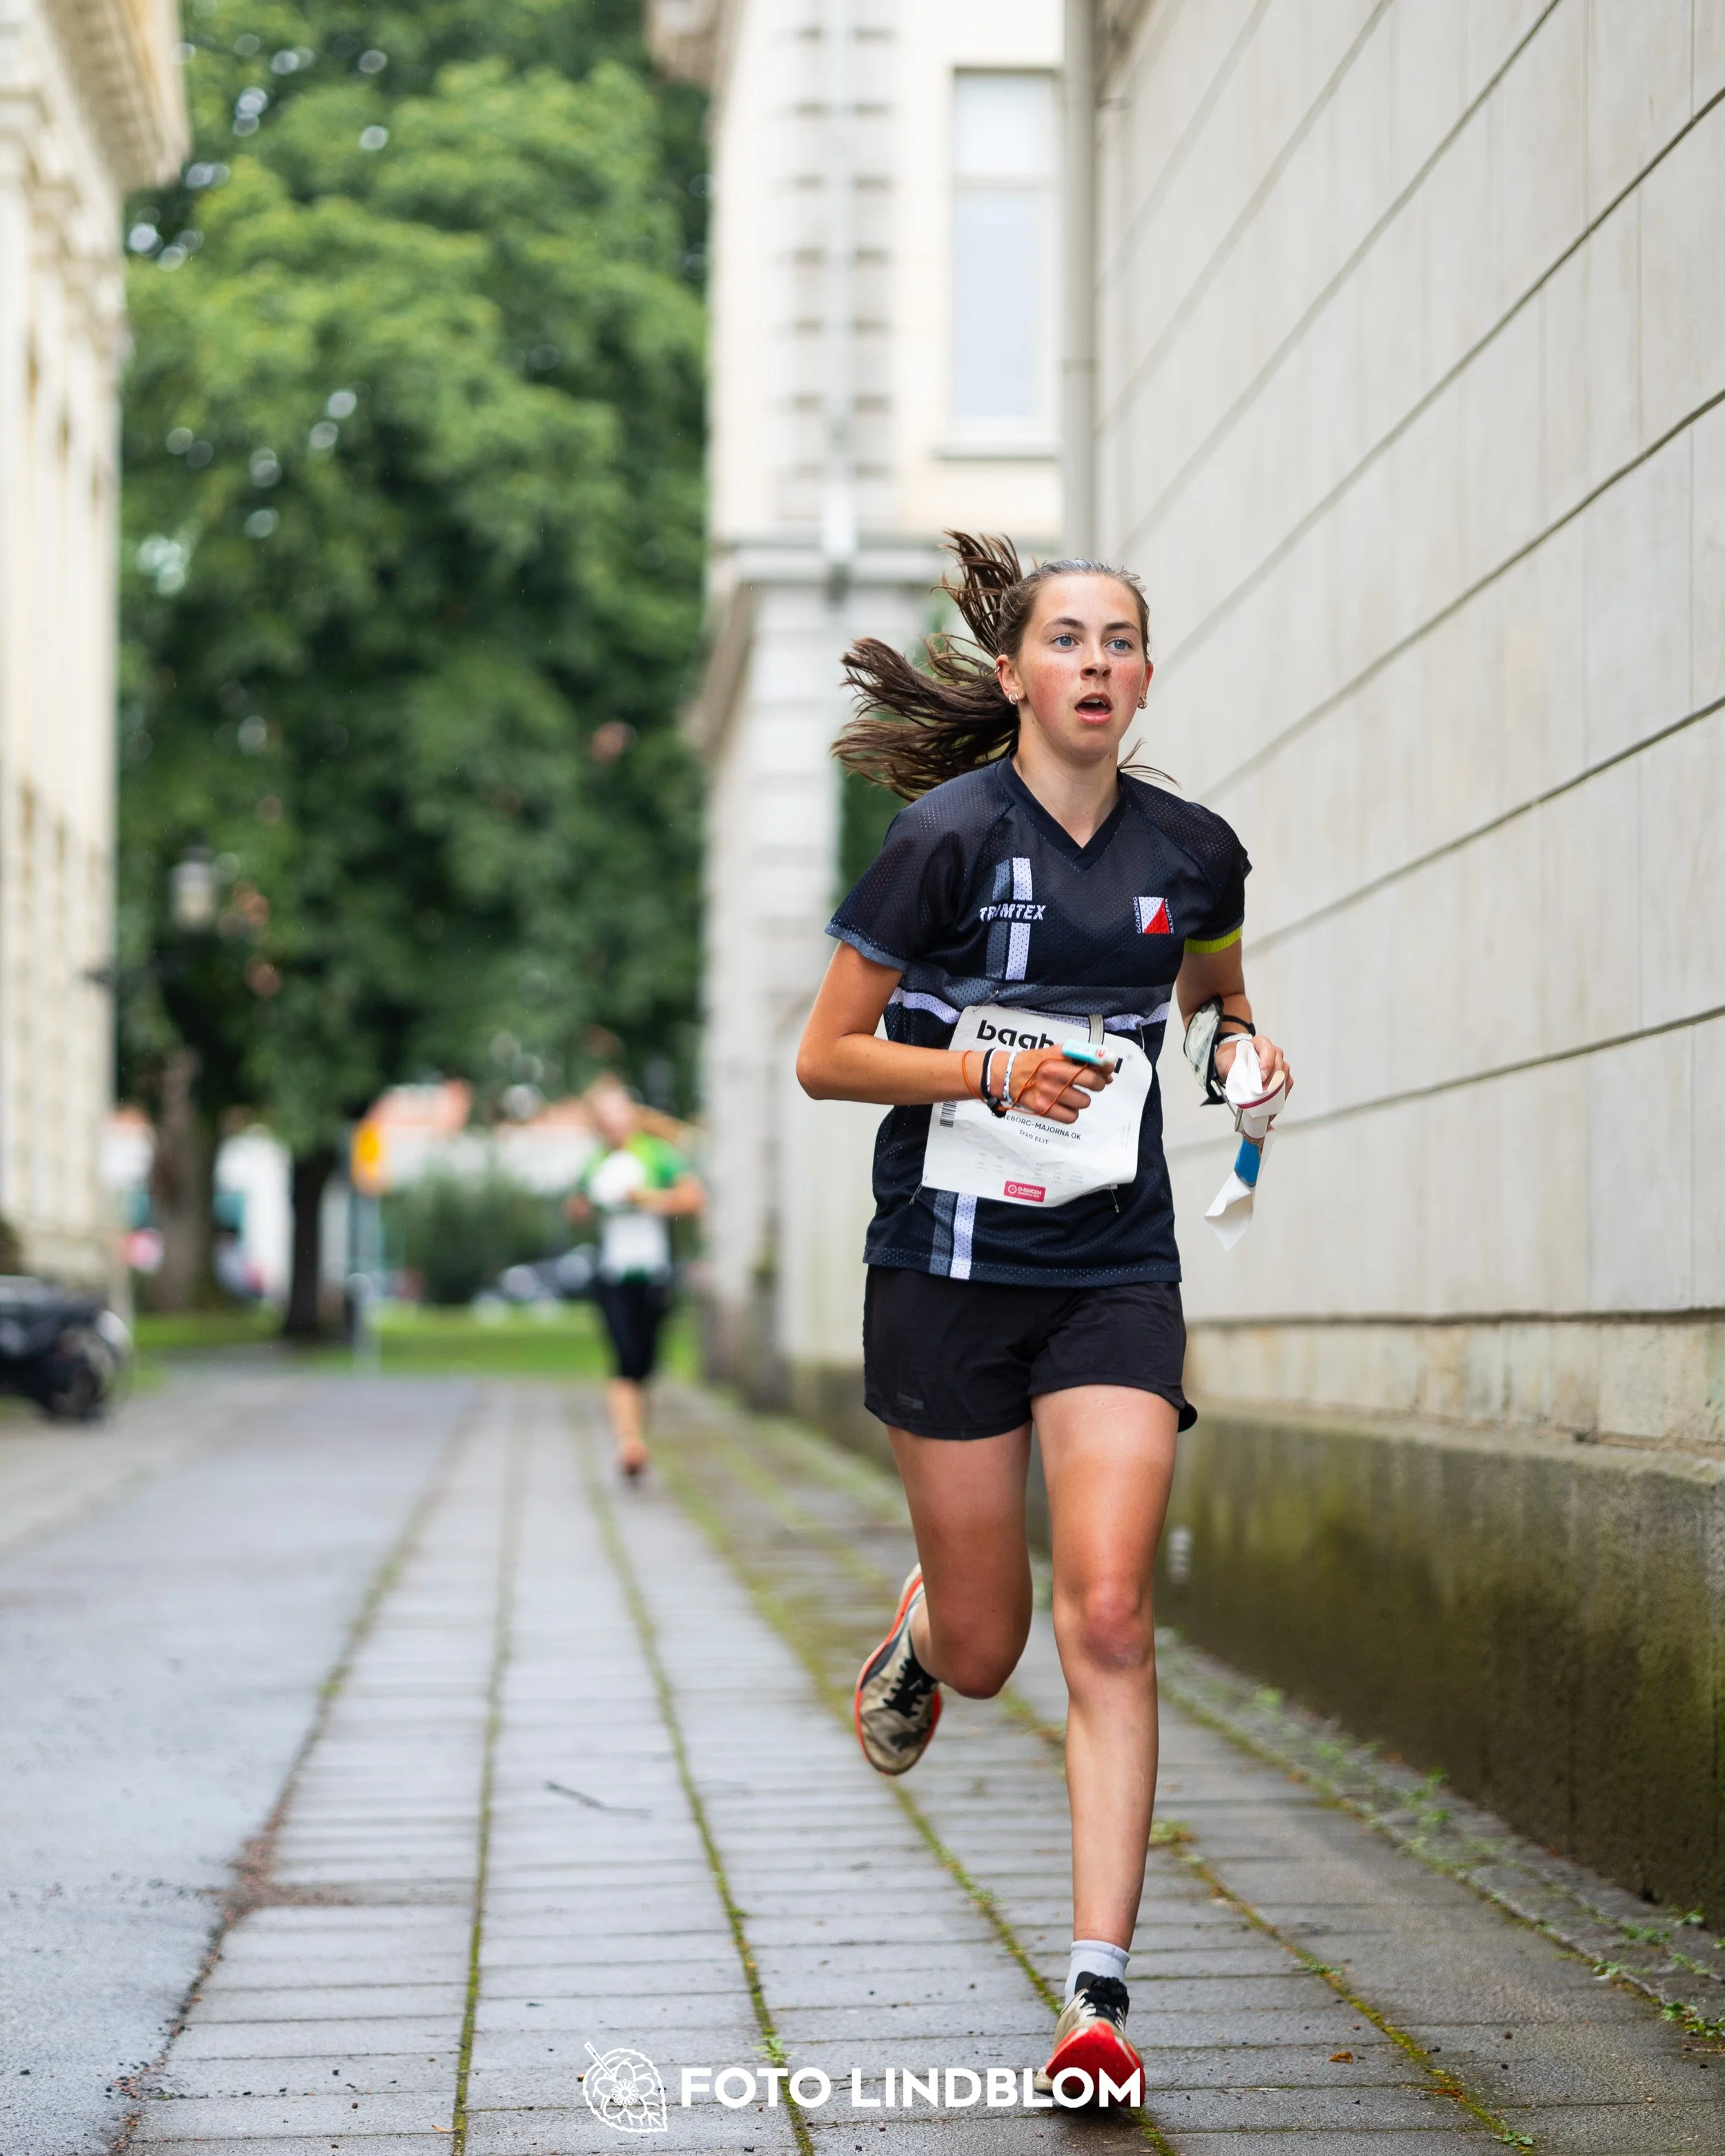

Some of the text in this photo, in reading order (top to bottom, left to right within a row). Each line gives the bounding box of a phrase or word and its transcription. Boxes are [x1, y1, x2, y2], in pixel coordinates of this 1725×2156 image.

[979, 903, 1047, 922] TRIMTEX
[1165, 898, 1175, 933] MAJORNA
[1020, 1129, 1049, 1145] D20 ELIT
[1071, 1132, 1081, 1140] OK
